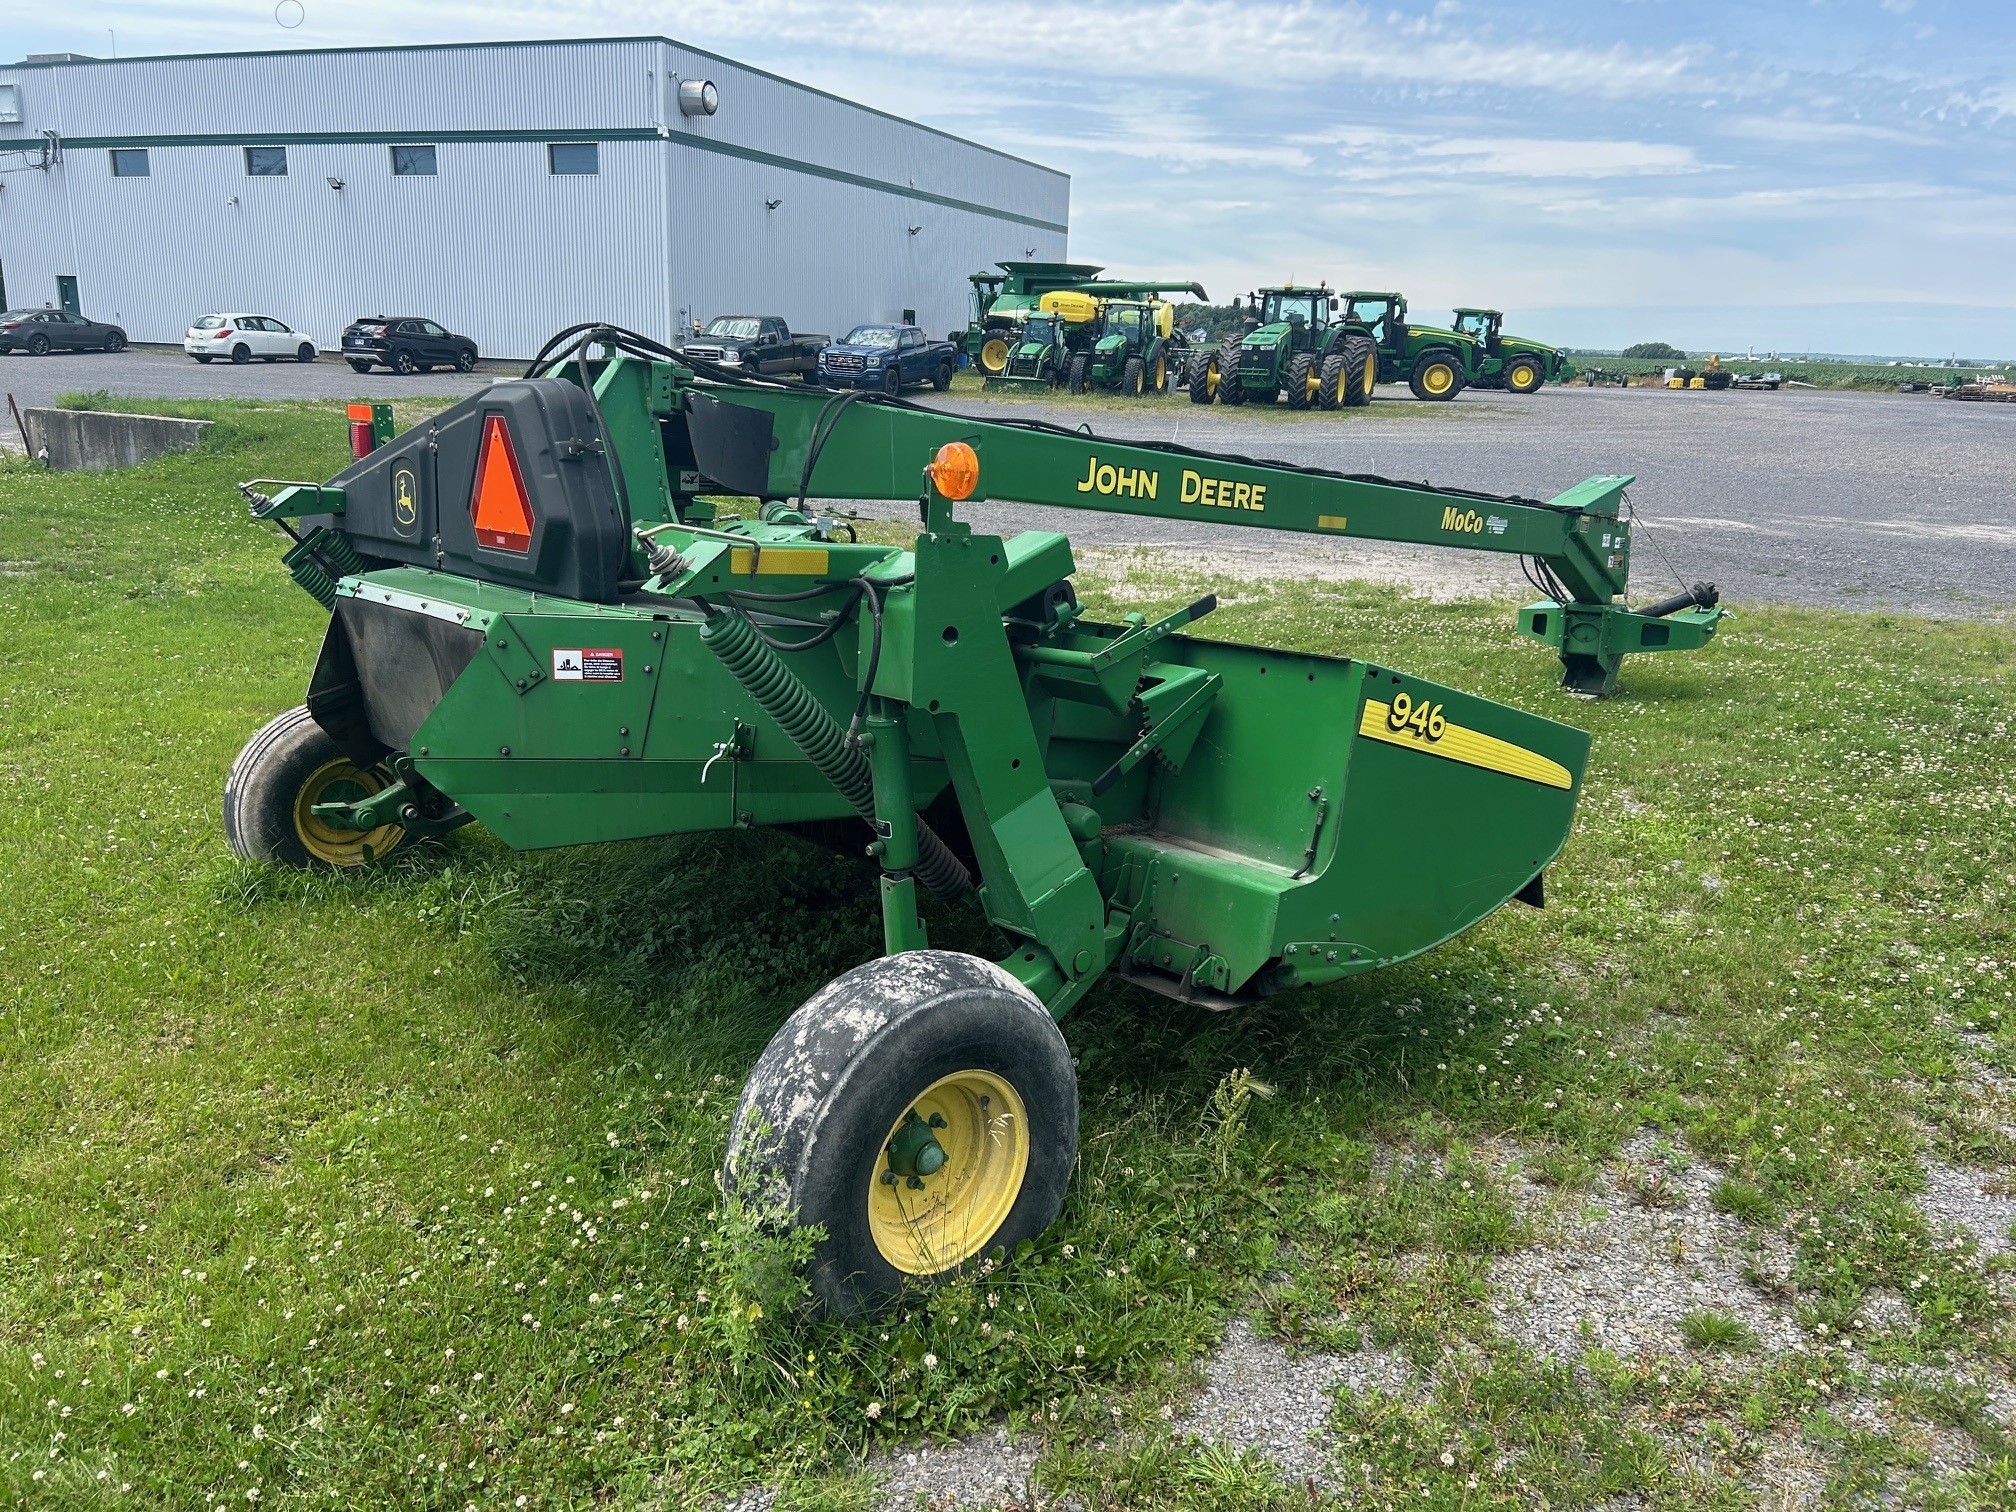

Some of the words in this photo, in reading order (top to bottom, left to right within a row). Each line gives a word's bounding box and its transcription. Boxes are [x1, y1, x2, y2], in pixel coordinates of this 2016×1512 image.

[1077, 456, 1159, 499] JOHN
[1180, 469, 1267, 511] DEERE
[1440, 506, 1483, 534] MoCo
[1388, 692, 1446, 741] 946
